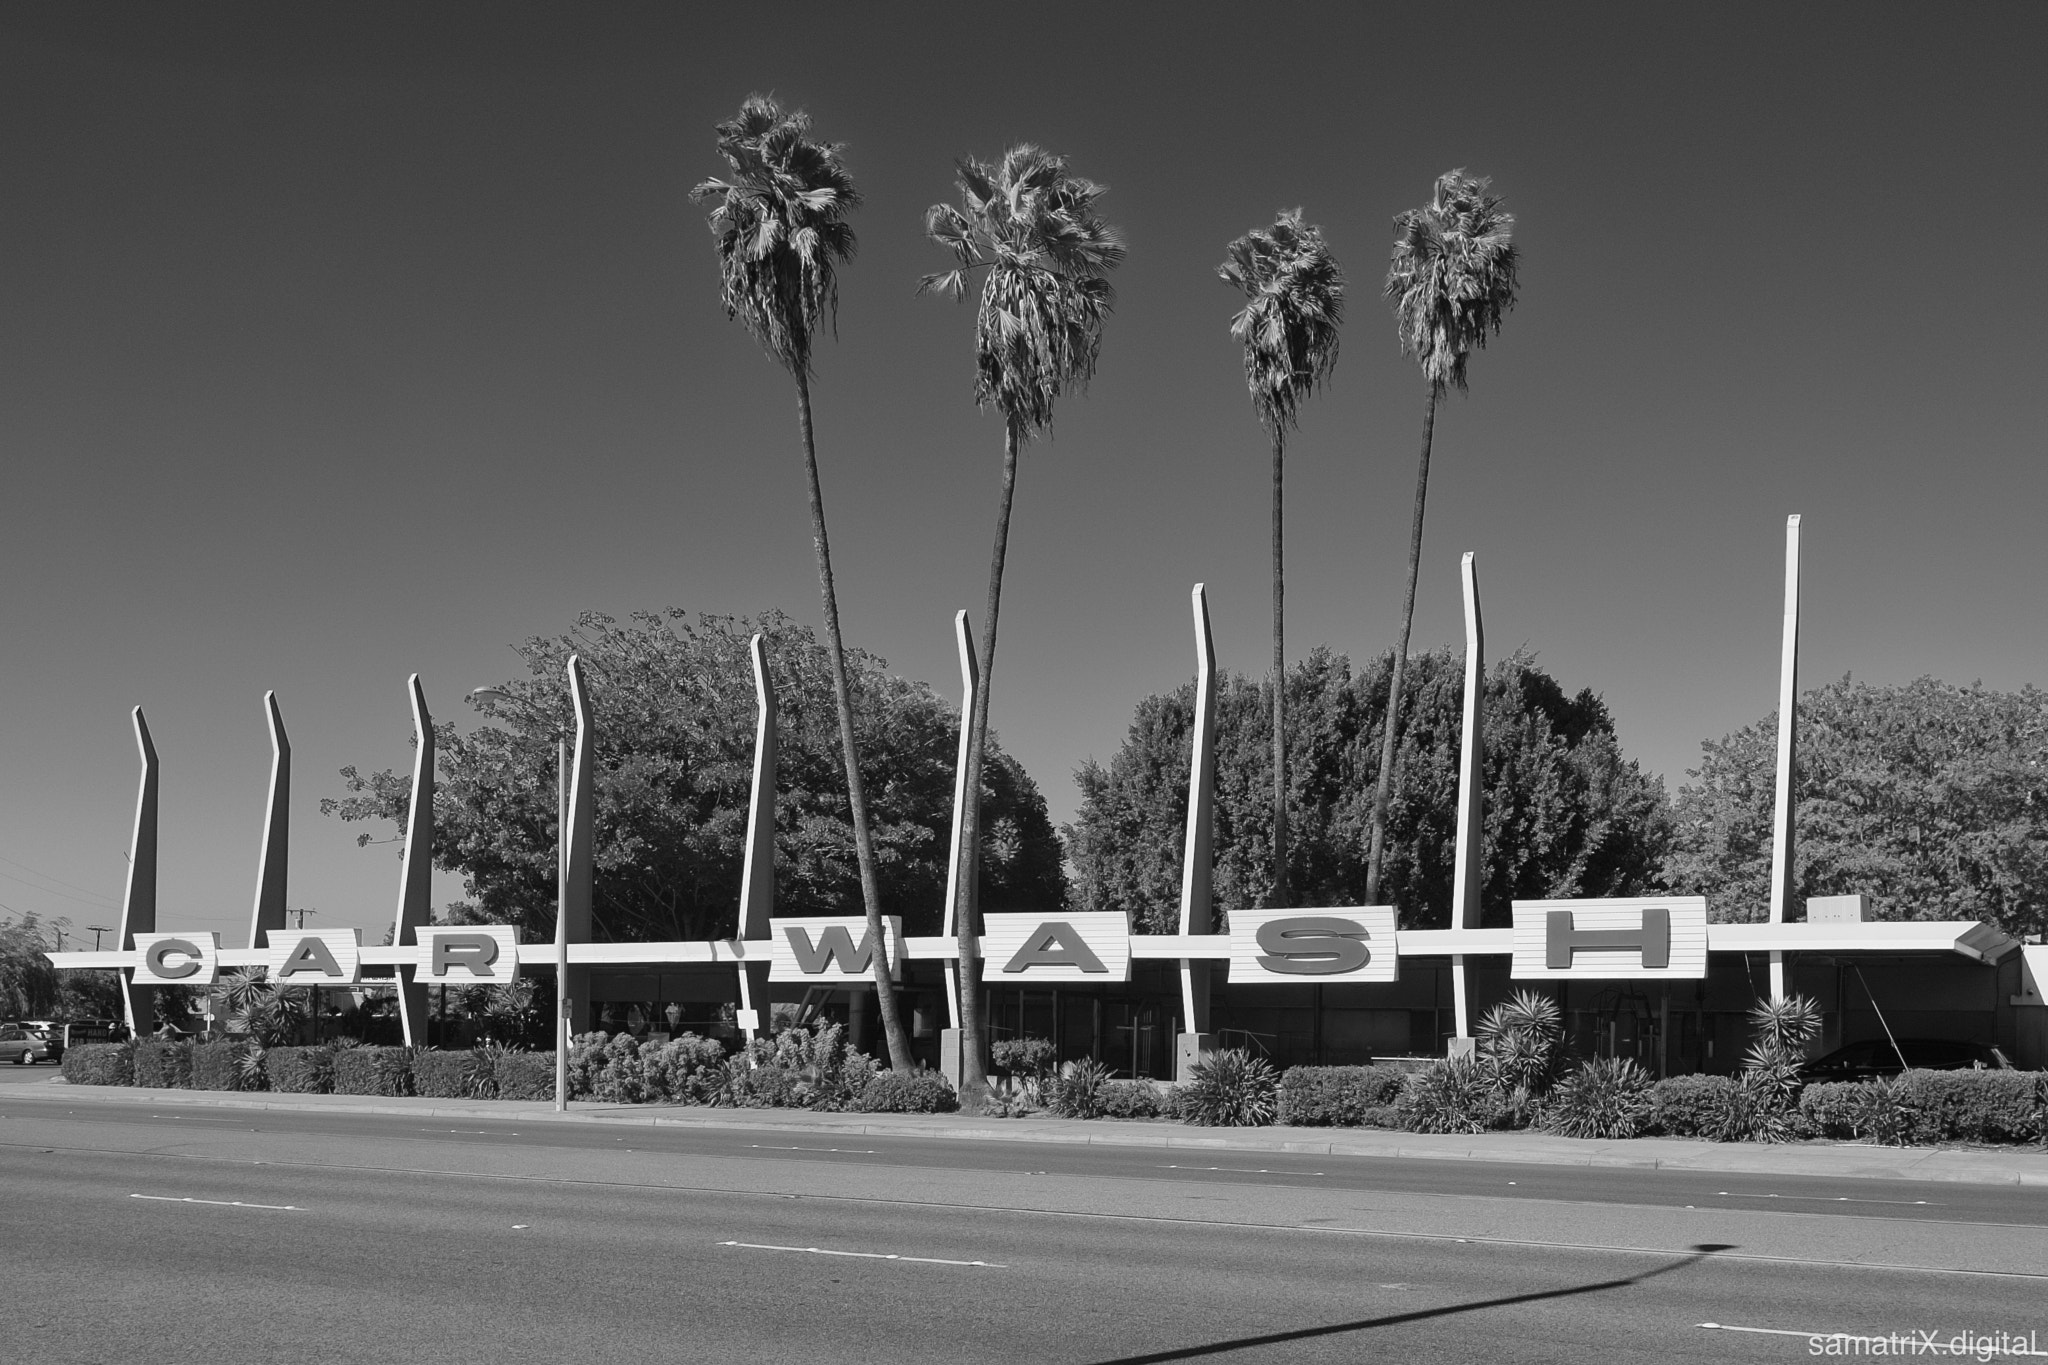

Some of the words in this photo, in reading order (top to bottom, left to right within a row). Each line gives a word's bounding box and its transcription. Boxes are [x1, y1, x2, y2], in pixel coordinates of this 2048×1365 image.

[145, 933, 500, 979] CAR
[783, 908, 1671, 975] WASH
[87, 1028, 107, 1037] HAND
